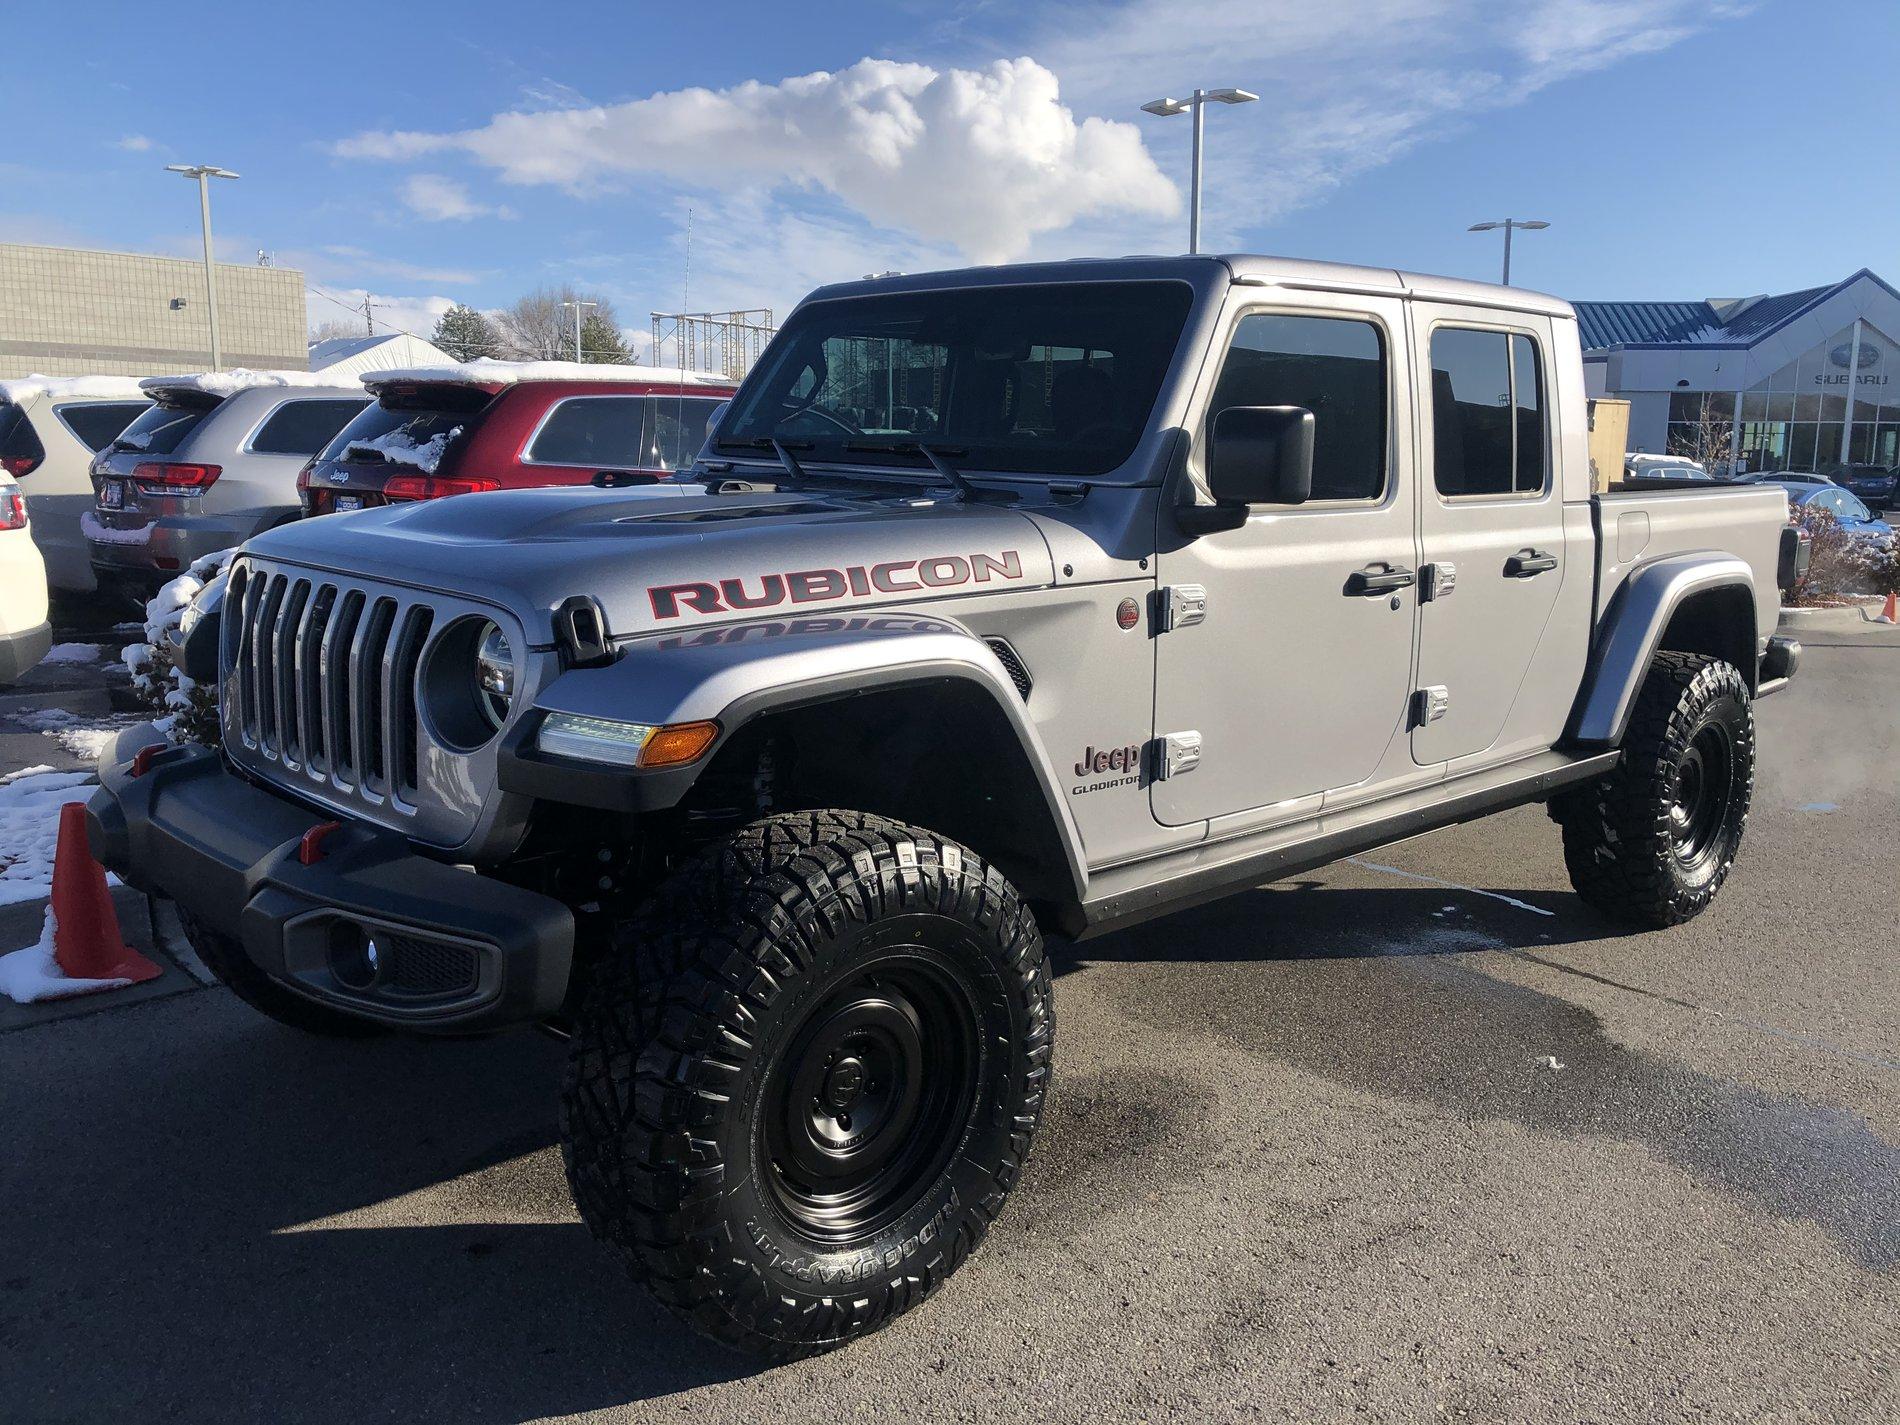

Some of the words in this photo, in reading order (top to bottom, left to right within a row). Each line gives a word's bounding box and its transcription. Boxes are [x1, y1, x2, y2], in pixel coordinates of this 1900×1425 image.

[1814, 374, 1889, 385] SUBARU
[330, 469, 349, 483] Jeep
[646, 550, 1023, 620] RUBICON
[1074, 746, 1140, 777] Jeep
